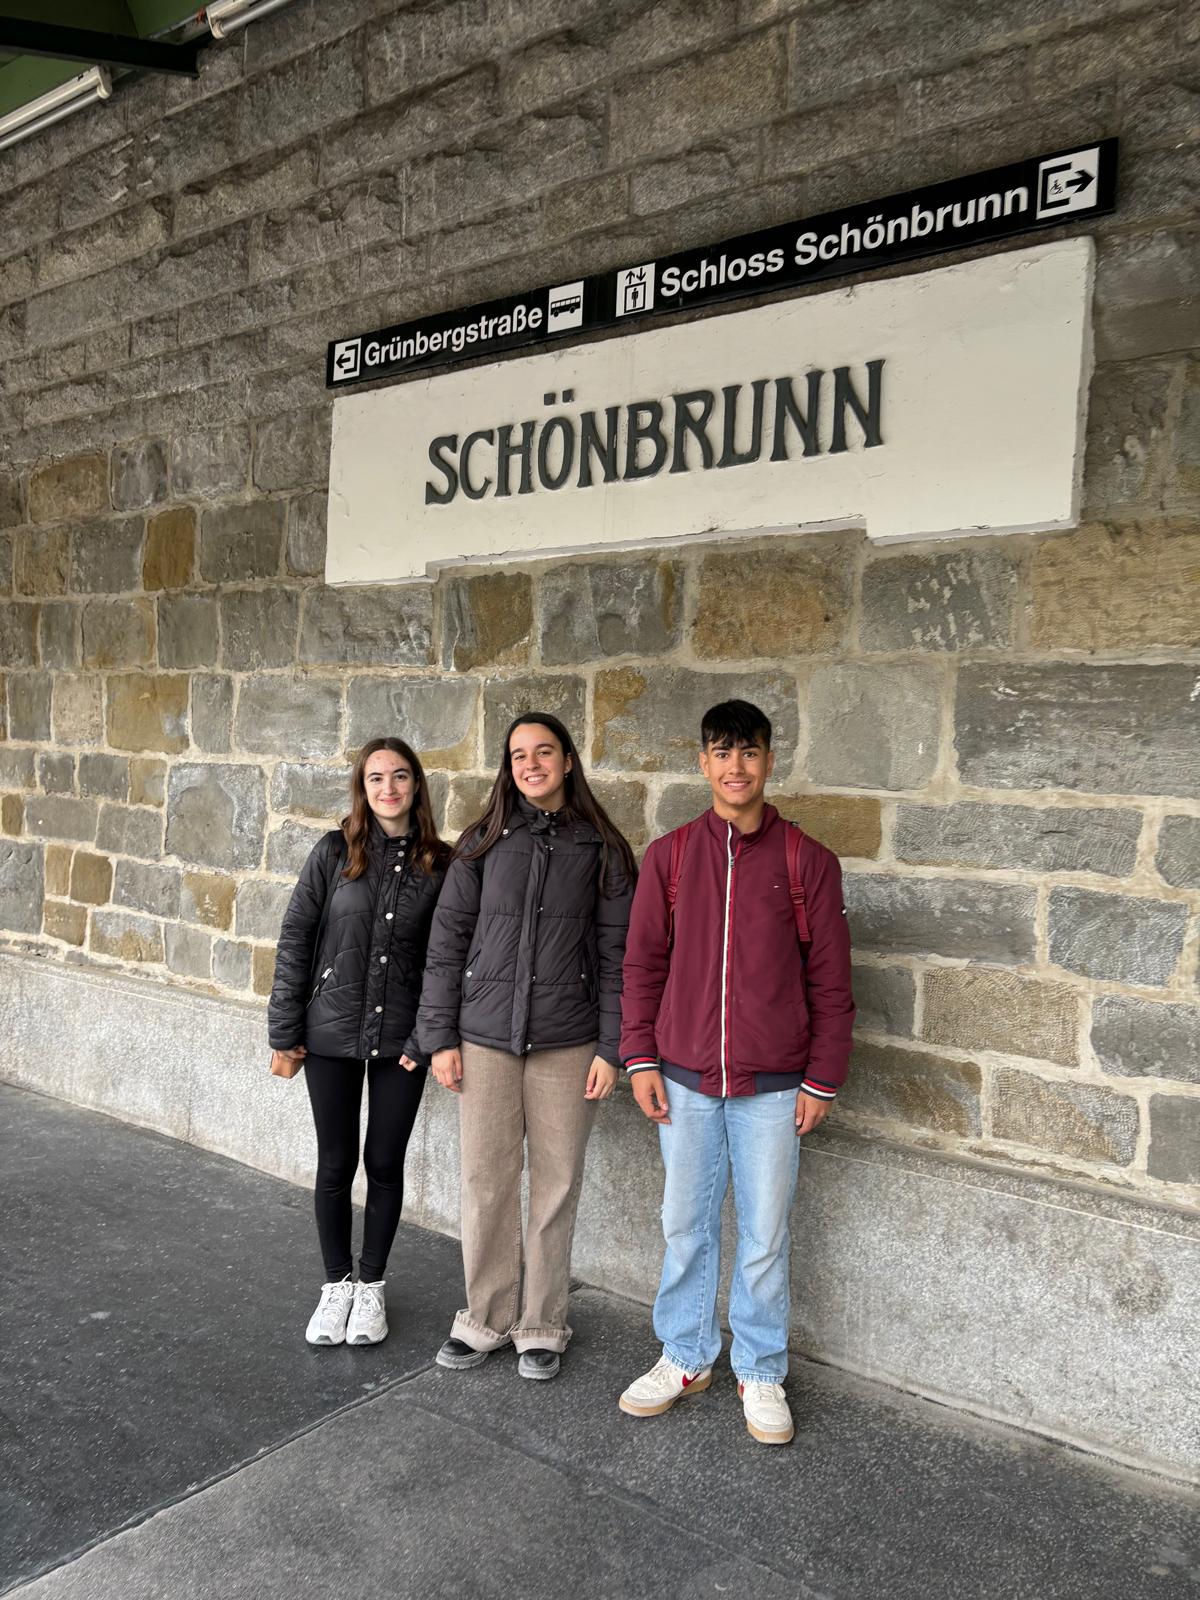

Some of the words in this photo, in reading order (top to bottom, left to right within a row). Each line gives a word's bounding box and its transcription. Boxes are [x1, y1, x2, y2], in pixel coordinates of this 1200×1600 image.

[661, 246, 784, 297] Schloss
[794, 185, 1028, 265] Schönbrunn
[364, 305, 542, 367] Grünbergstraße
[425, 359, 886, 505] SCHÖNBRUNN
